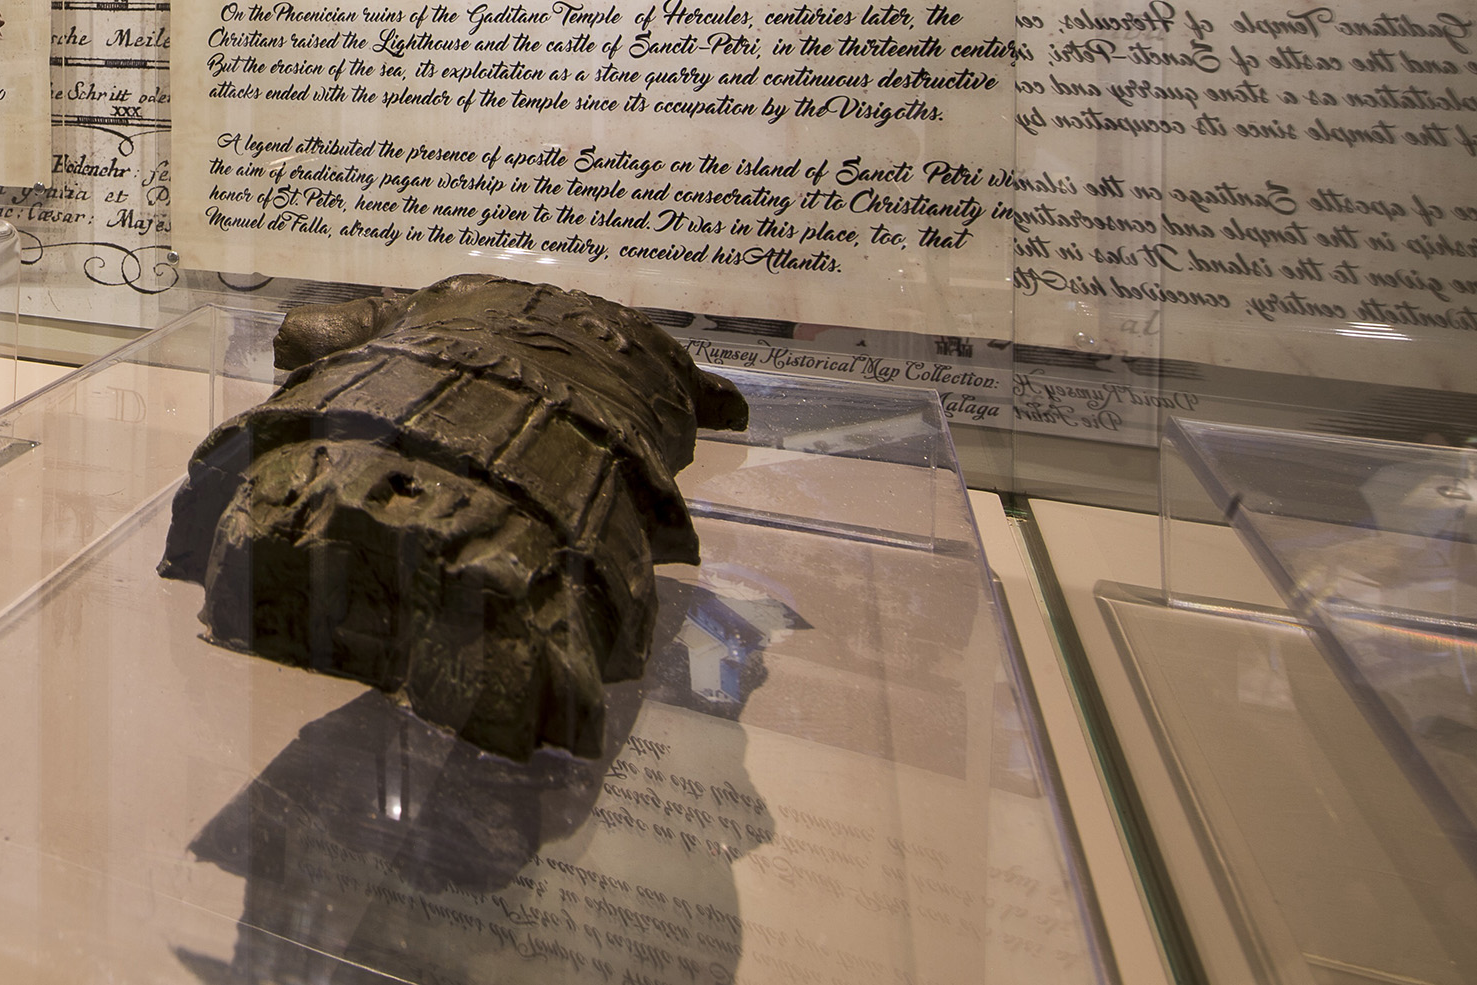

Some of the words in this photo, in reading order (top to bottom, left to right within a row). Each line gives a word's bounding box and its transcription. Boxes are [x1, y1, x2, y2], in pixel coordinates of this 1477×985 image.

[220, 2, 246, 23] On
[248, 4, 272, 22] the
[272, 2, 357, 23] Phoenician
[362, 9, 405, 23] ruins
[409, 5, 428, 28] of
[431, 4, 458, 23] the
[467, 3, 551, 35] Gaditano
[552, 1, 622, 29] Temple
[635, 6, 656, 31] of
[765, 5, 857, 26] centuries
[861, 3, 914, 31] later,
[926, 3, 963, 26] the
[208, 27, 285, 48] Christians
[291, 32, 338, 49] raised
[342, 29, 368, 49] the
[373, 29, 471, 57] Lighthouse
[475, 31, 511, 52] and
[513, 33, 541, 52] the
[546, 34, 597, 53] castle
[601, 34, 622, 59] of
[629, 32, 761, 60] Sancti-Petri,
[772, 38, 794, 56] in
[800, 35, 834, 56] the
[838, 36, 945, 56] thirteenth
[216, 133, 243, 153] A
[244, 135, 293, 160] legend
[295, 137, 375, 159] attributed
[378, 139, 404, 159] the
[406, 146, 477, 165] presence
[481, 146, 501, 169] of
[504, 148, 568, 170] apostle
[574, 145, 666, 179] Santiago
[670, 160, 695, 175] on
[699, 153, 731, 176] the
[736, 157, 800, 179] island
[805, 160, 827, 187] of
[835, 156, 914, 186] Sancti
[924, 160, 984, 187] Petri
[205, 205, 266, 230] Manuel
[267, 220, 284, 233] de
[281, 211, 332, 239] Falla,
[339, 220, 402, 246] already
[406, 226, 424, 242] in
[428, 226, 456, 245] the
[459, 226, 536, 250] twentieth
[541, 236, 609, 262] century,
[619, 243, 708, 263] conceived
[712, 249, 743, 267] his
[742, 247, 842, 274] Atlantis.
